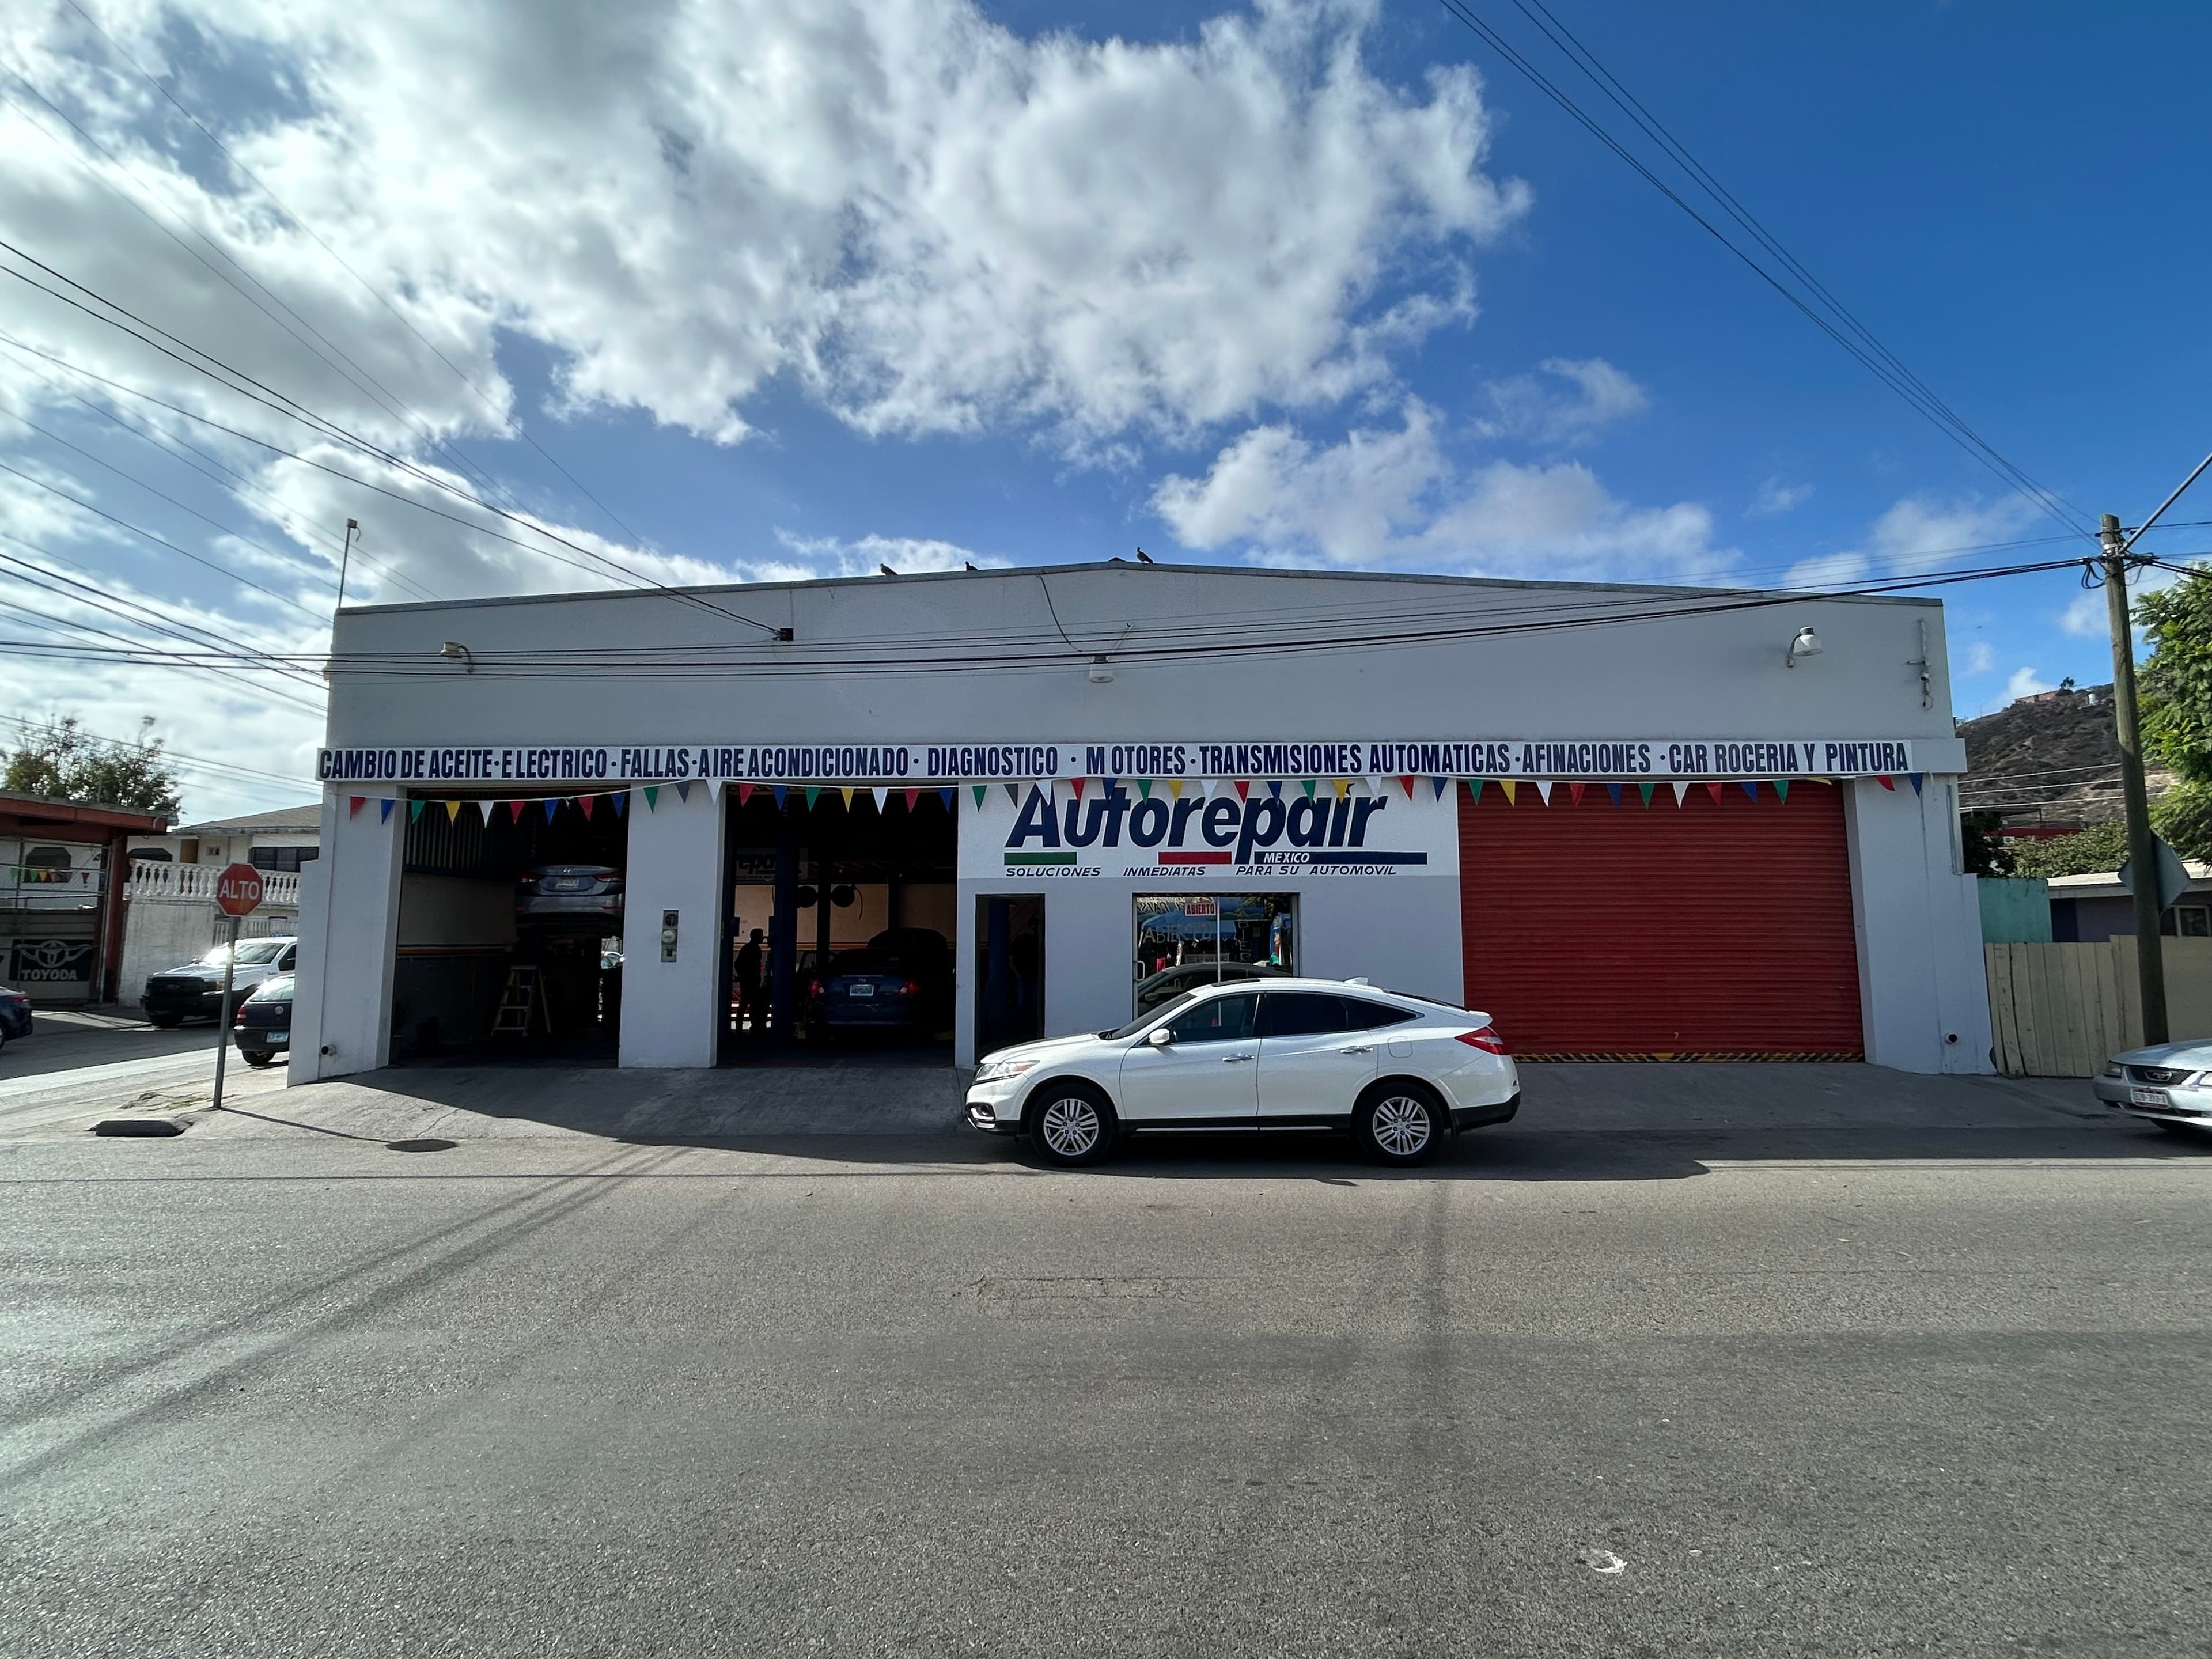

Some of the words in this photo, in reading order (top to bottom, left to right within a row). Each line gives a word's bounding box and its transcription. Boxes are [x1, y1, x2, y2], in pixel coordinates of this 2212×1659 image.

[320, 750, 396, 778] CAMBIO
[400, 750, 425, 778] DE
[428, 750, 493, 778] ACEITE
[621, 749, 689, 778] FALLAS
[698, 749, 744, 777] AIRE
[748, 748, 908, 777] ACONDICIONADO
[928, 747, 1057, 776] DIAGNOSTICO
[1199, 745, 1361, 774] TRANSMISIONES
[1369, 744, 1510, 773] AUTOMATICAS
[1522, 744, 1650, 773] AFINACIONES
[1804, 744, 1815, 772] Y
[1825, 743, 1908, 772] PINTURA
[1005, 782, 1388, 864] Autorepair
[1263, 853, 1310, 863] MEXICO
[1006, 867, 1101, 877] SOLUCIONES
[1123, 866, 1206, 877] INMEDIATAS
[1235, 866, 1272, 876] PARA
[1278, 866, 1300, 875] SU
[1309, 865, 1397, 876] AUTOMOVIL
[219, 879, 260, 900] ALTO
[1187, 903, 1214, 915] ABIERTO
